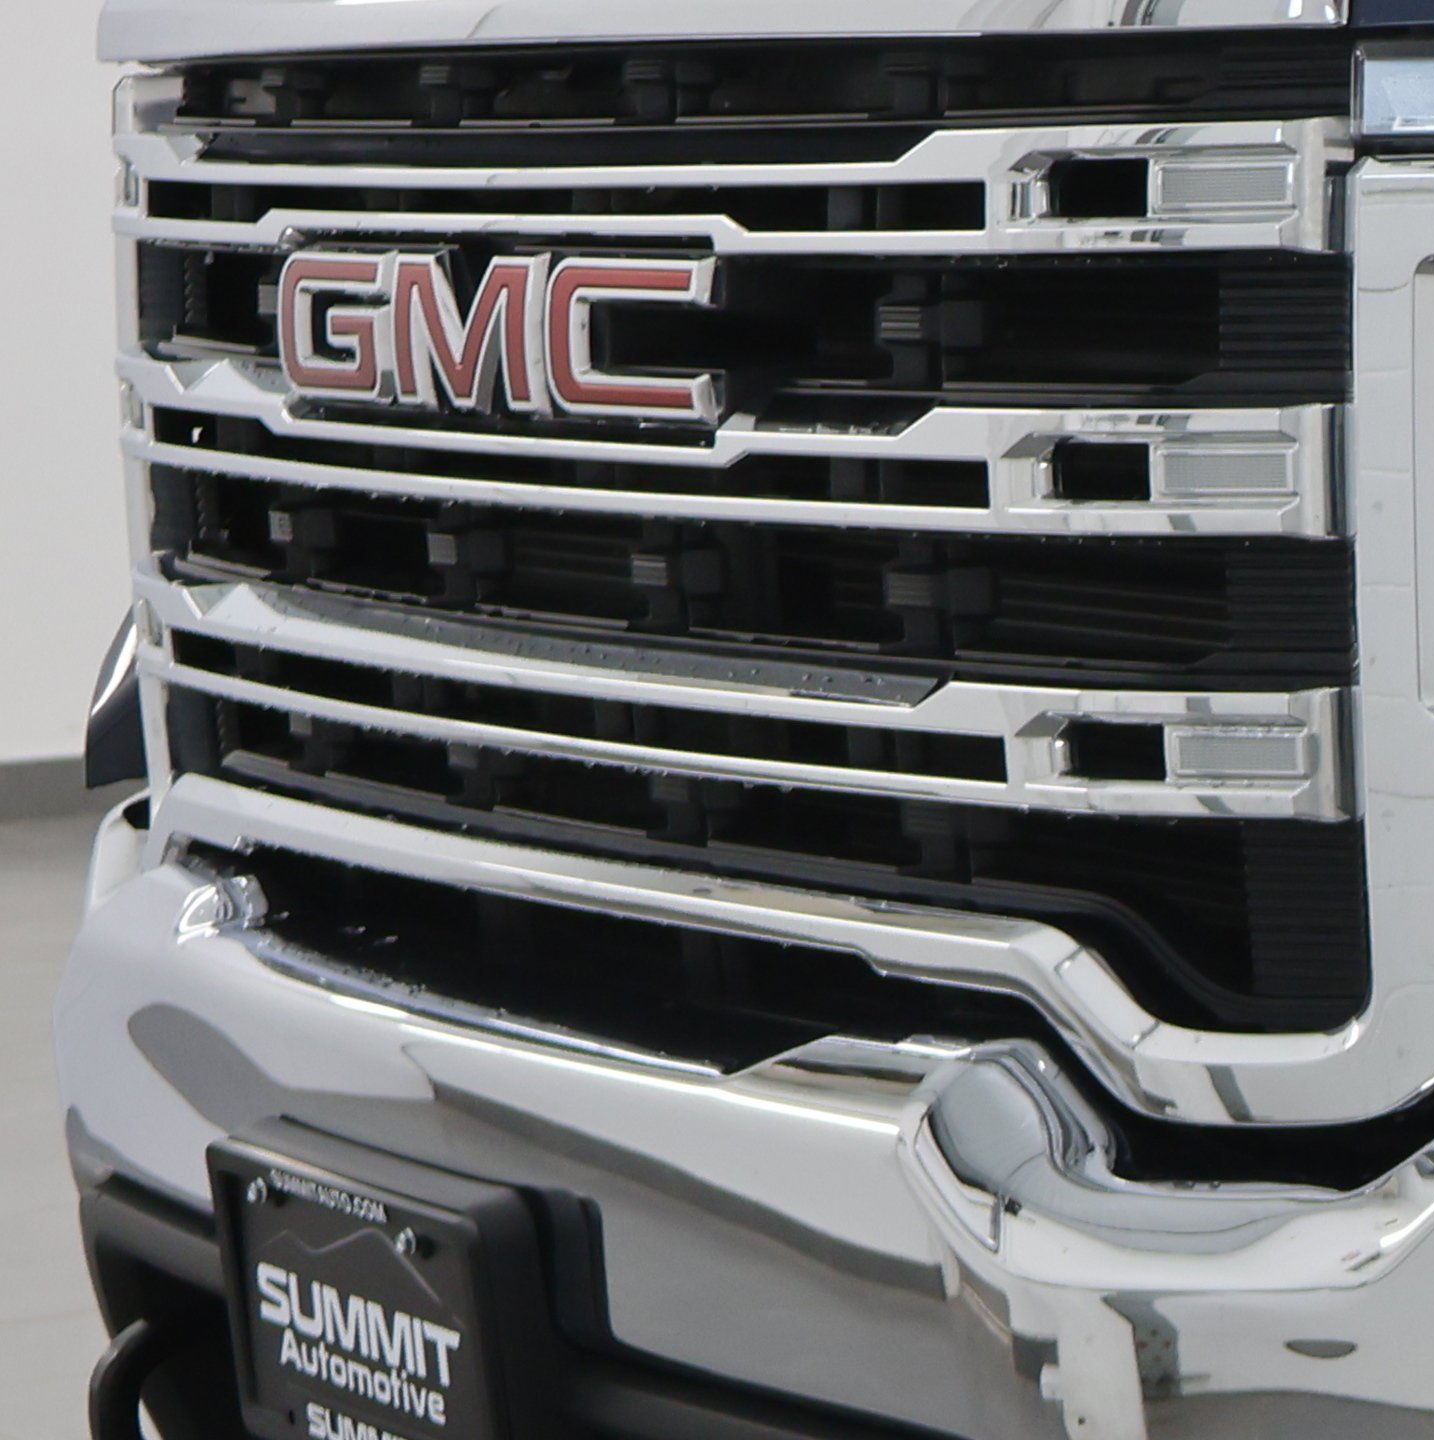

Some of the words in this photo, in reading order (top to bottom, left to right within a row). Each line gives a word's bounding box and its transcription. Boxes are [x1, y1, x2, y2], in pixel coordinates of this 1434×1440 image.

[278, 250, 722, 422] GMC
[256, 1261, 461, 1388] SUMMIT
[280, 1328, 447, 1426] Automotive
